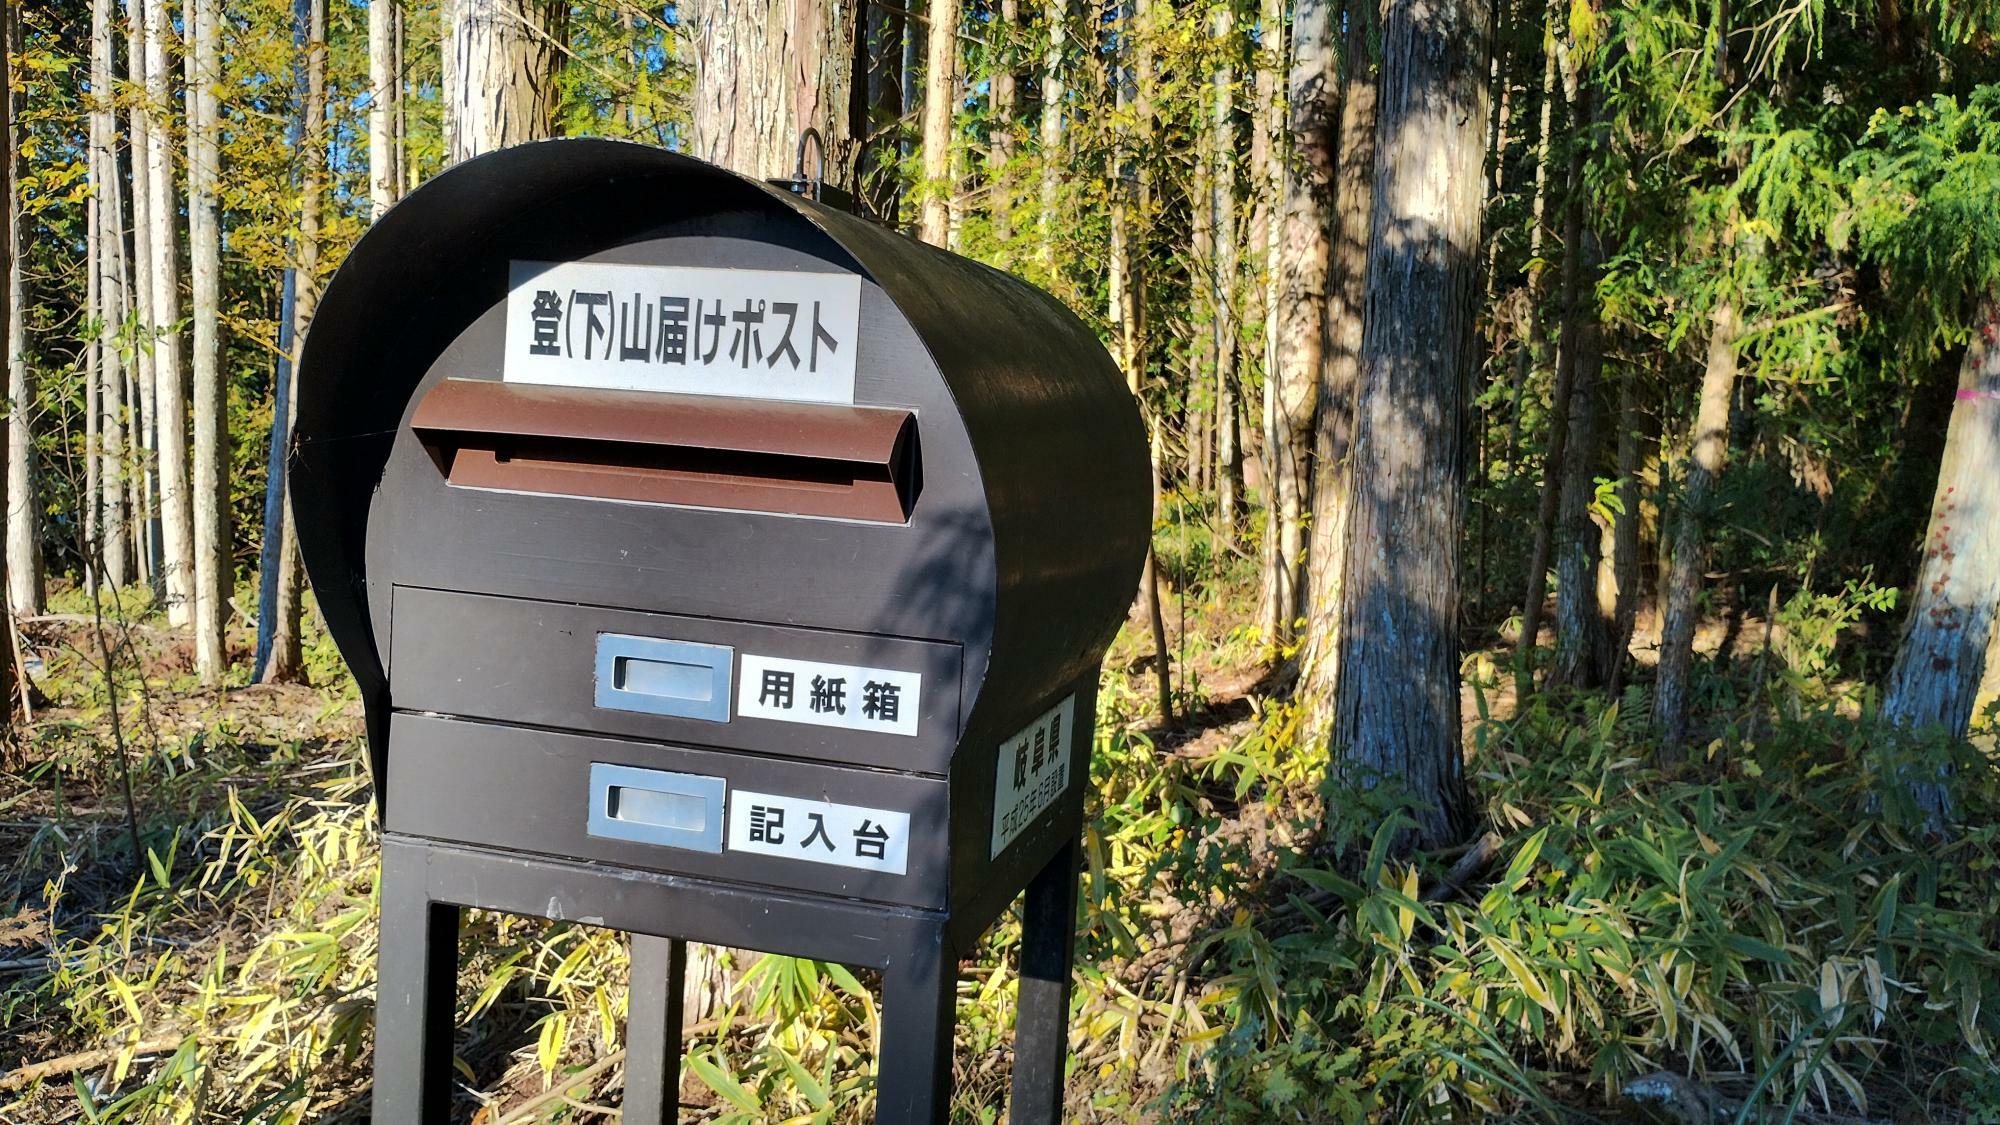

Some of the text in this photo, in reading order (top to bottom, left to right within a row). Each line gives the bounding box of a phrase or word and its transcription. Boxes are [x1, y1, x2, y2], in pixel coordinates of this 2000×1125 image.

[530, 289, 838, 373] 登(下)山届けポスト
[759, 669, 901, 722] 用紙箱
[1013, 713, 1061, 792] 岐阜県
[749, 805, 889, 860] 記入台
